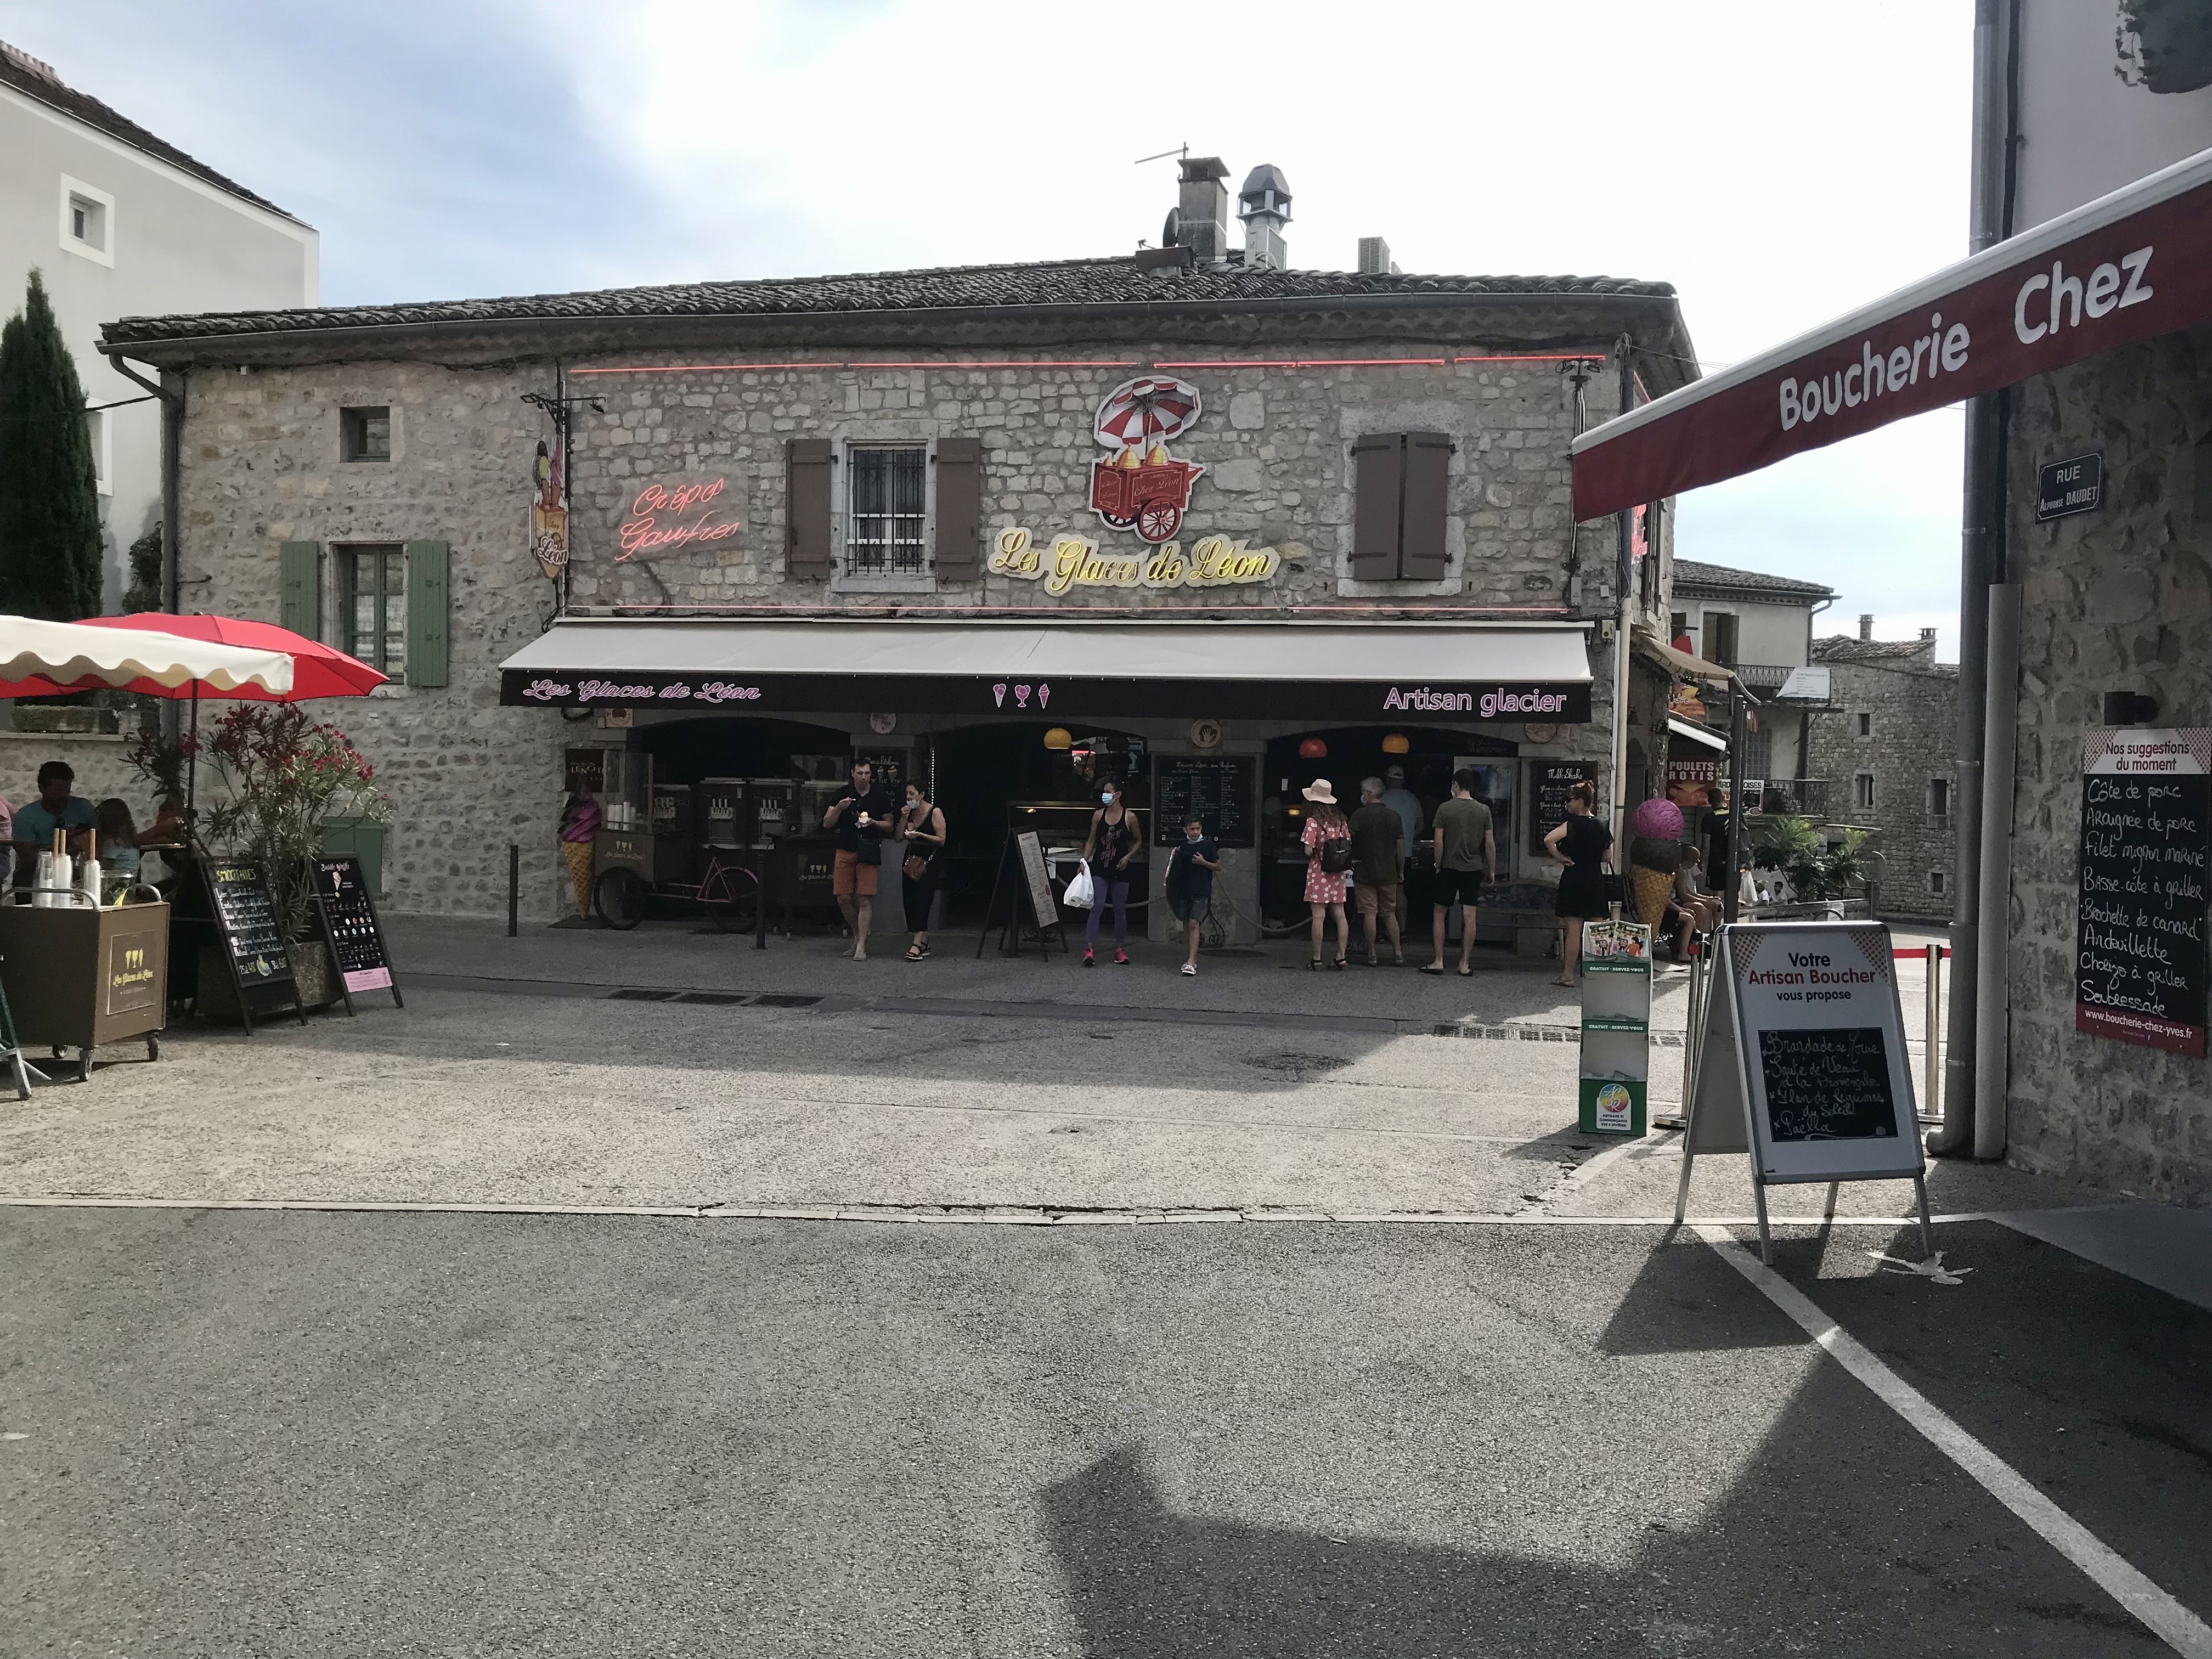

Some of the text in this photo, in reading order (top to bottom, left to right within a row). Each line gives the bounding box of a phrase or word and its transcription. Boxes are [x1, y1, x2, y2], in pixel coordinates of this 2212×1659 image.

[1779, 246, 2154, 431] Boucherie Chez
[2057, 465, 2080, 484] RUE
[1135, 485, 1154, 496] Chez
[2066, 486, 2097, 505] DAUDET
[614, 510, 740, 561] Gaufres
[994, 531, 1271, 591] Les Glaces de Léon
[523, 679, 761, 703] Les Glaces de Léon
[1383, 687, 1567, 718] Artisan glacier
[2106, 741, 2190, 758] Nos suggestions
[571, 763, 602, 774] LENÔT
[1669, 761, 1714, 771] POULETS
[2116, 757, 2177, 771] du moment
[1669, 771, 1714, 781] ROTIS
[2088, 778, 2122, 803] Côte
[2126, 780, 2141, 799] de
[2147, 811, 2164, 831] de
[2085, 831, 2116, 857] Filet
[2122, 843, 2161, 874] mignon
[217, 868, 256, 882] SMOOTHIES
[2154, 876, 2162, 894] à
[2081, 898, 2129, 927] Brochette
[2136, 909, 2148, 927] de
[2085, 923, 2172, 964] Andouillette
[1788, 952, 1830, 967] Votre
[1748, 966, 1876, 985] Artisan Boucher
[2080, 951, 2128, 990] Chorizo
[2131, 965, 2141, 979] à
[1776, 990, 1851, 1003] vous propose
[2081, 980, 2168, 1019] Soubressade
[2085, 1009, 2193, 1039] www.boucherie-chez-yves.fr
[1765, 1030, 1835, 1055] Brandade
[1836, 1041, 1847, 1052] de
[1770, 1055, 1807, 1077] Sauté
[1810, 1062, 1821, 1075] de
[1796, 1074, 1812, 1087] la
[1816, 1071, 1880, 1091] Provençale
[1814, 1090, 1828, 1104] de
[1803, 1103, 1856, 1117] du Soleil
[1781, 1110, 1837, 1135] Paëlla
